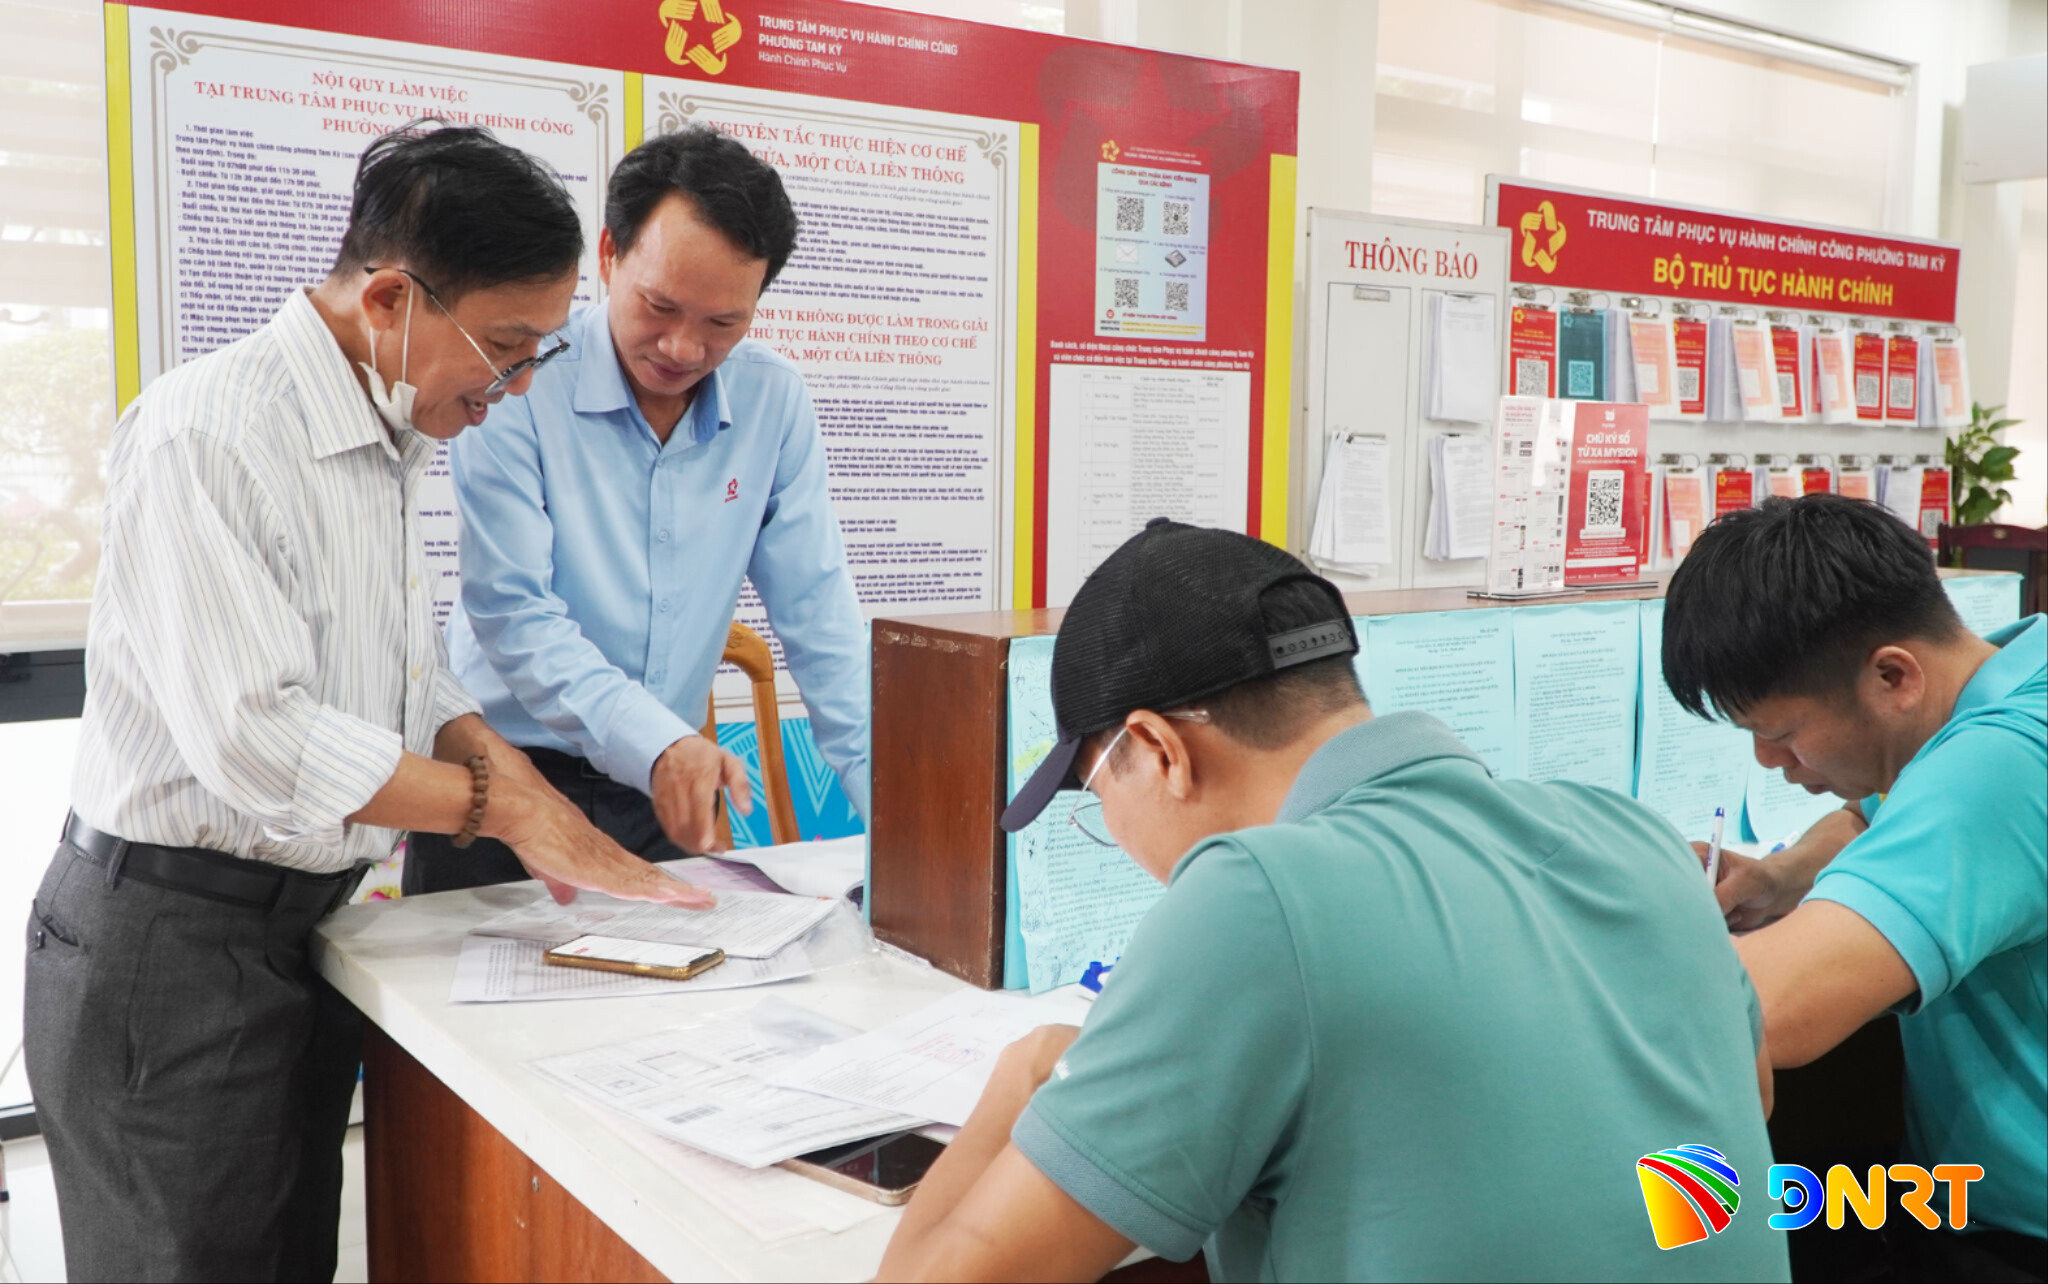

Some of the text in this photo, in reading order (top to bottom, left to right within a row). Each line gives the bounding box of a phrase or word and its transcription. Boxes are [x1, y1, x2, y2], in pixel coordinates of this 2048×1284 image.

[759, 15, 957, 55] TRUNG TÂM PHỤC VỤ HÀNH CHÍNH CÔNG
[759, 33, 842, 55] PHƯỜNG TAM KỲ
[759, 51, 847, 73] Hành Chính Phục Vụ
[313, 71, 467, 104] NỘI QUY LÀM VIỆC
[195, 81, 573, 135] TẠI TRUNG TÂM PHỤC VỤ HÀNH CHÍNH CÔNG
[708, 120, 967, 162] NGUYÊN TẮC THỰC HIỆN CƠ CHẾ
[795, 153, 828, 172] MỘT
[834, 155, 866, 174] CỬA
[872, 161, 907, 177] LIÊN
[911, 166, 964, 184] THÔNG
[1587, 209, 1946, 271] TRUNG TÂM PHỤC VỤ HÀNH CHÍNH CÔNG PHƯỜNG TAM KỲ
[1345, 237, 1478, 279] THÔNG BÁO
[1653, 253, 1893, 306] BỘ THỦ TỤC HÀNH CHÍNH
[746, 323, 976, 349] THỦ TỤC HÀNH CHÍNH THEO CƠ CHẾ
[779, 309, 792, 320] VI
[797, 310, 844, 323] KHÔNG
[847, 313, 883, 327] ĐƯỢC
[887, 314, 913, 327] LÀM
[917, 318, 959, 329] TRONG
[962, 318, 988, 331] GIẢI
[803, 347, 831, 363] MỘT
[835, 347, 861, 362] CỬA
[865, 350, 894, 363] LIÊN
[898, 352, 941, 365] THÔNG
